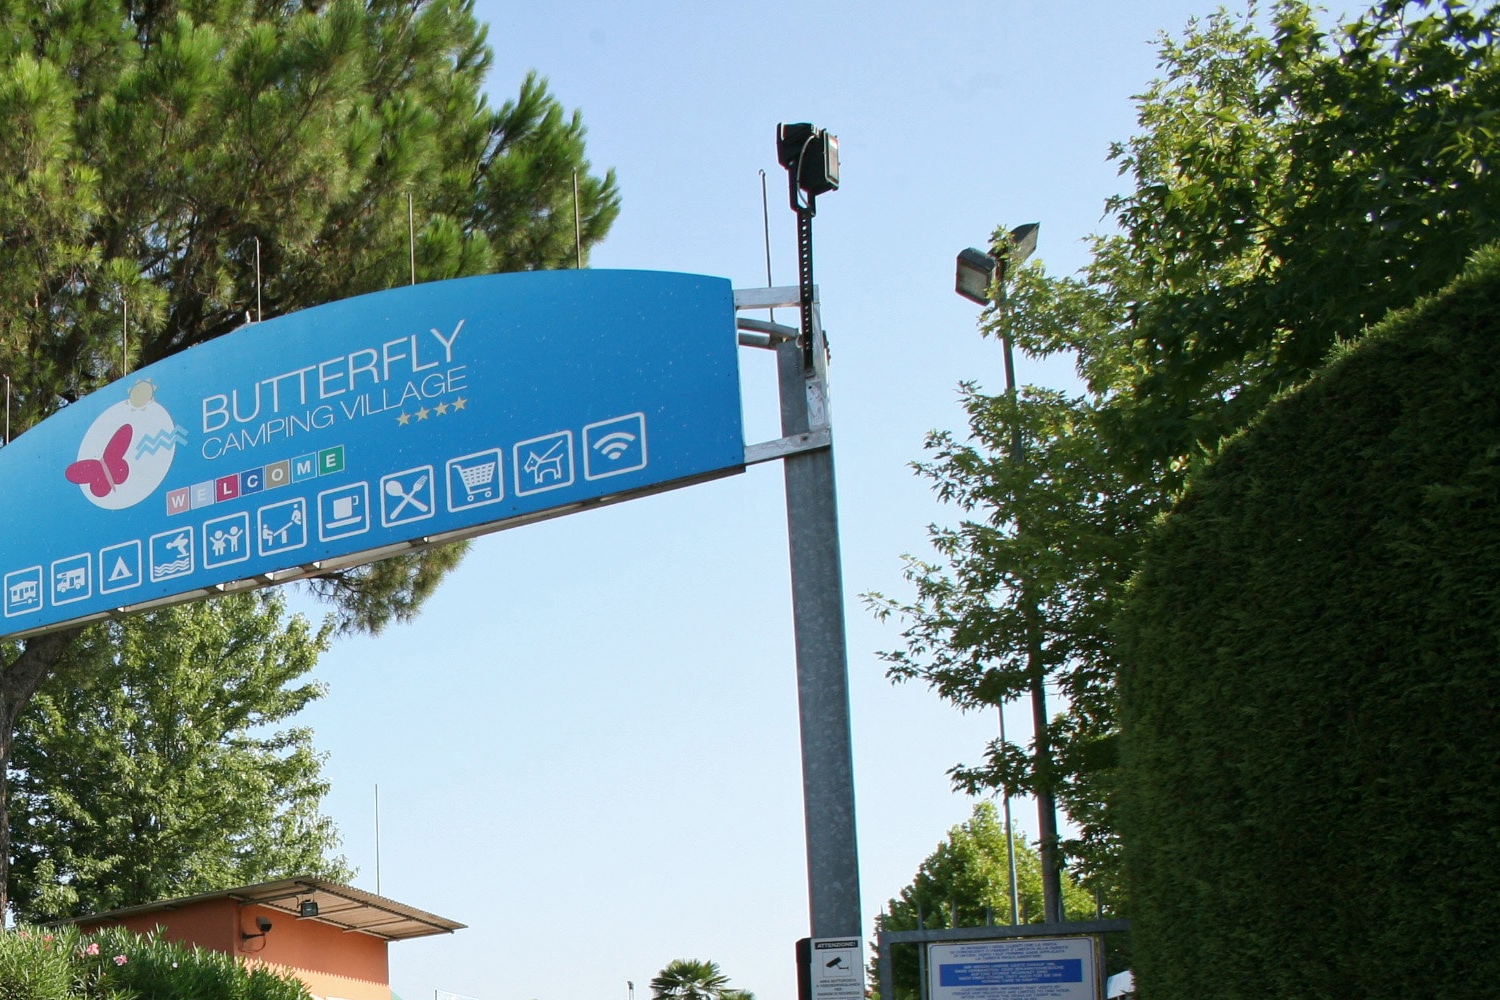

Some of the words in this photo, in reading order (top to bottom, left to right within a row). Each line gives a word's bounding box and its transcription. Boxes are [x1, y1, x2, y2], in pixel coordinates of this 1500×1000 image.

[202, 319, 466, 433] BUTTERFLY
[202, 405, 334, 460] CAMPING
[340, 366, 468, 421] VILLAGE
[170, 451, 338, 510] WELCOME
